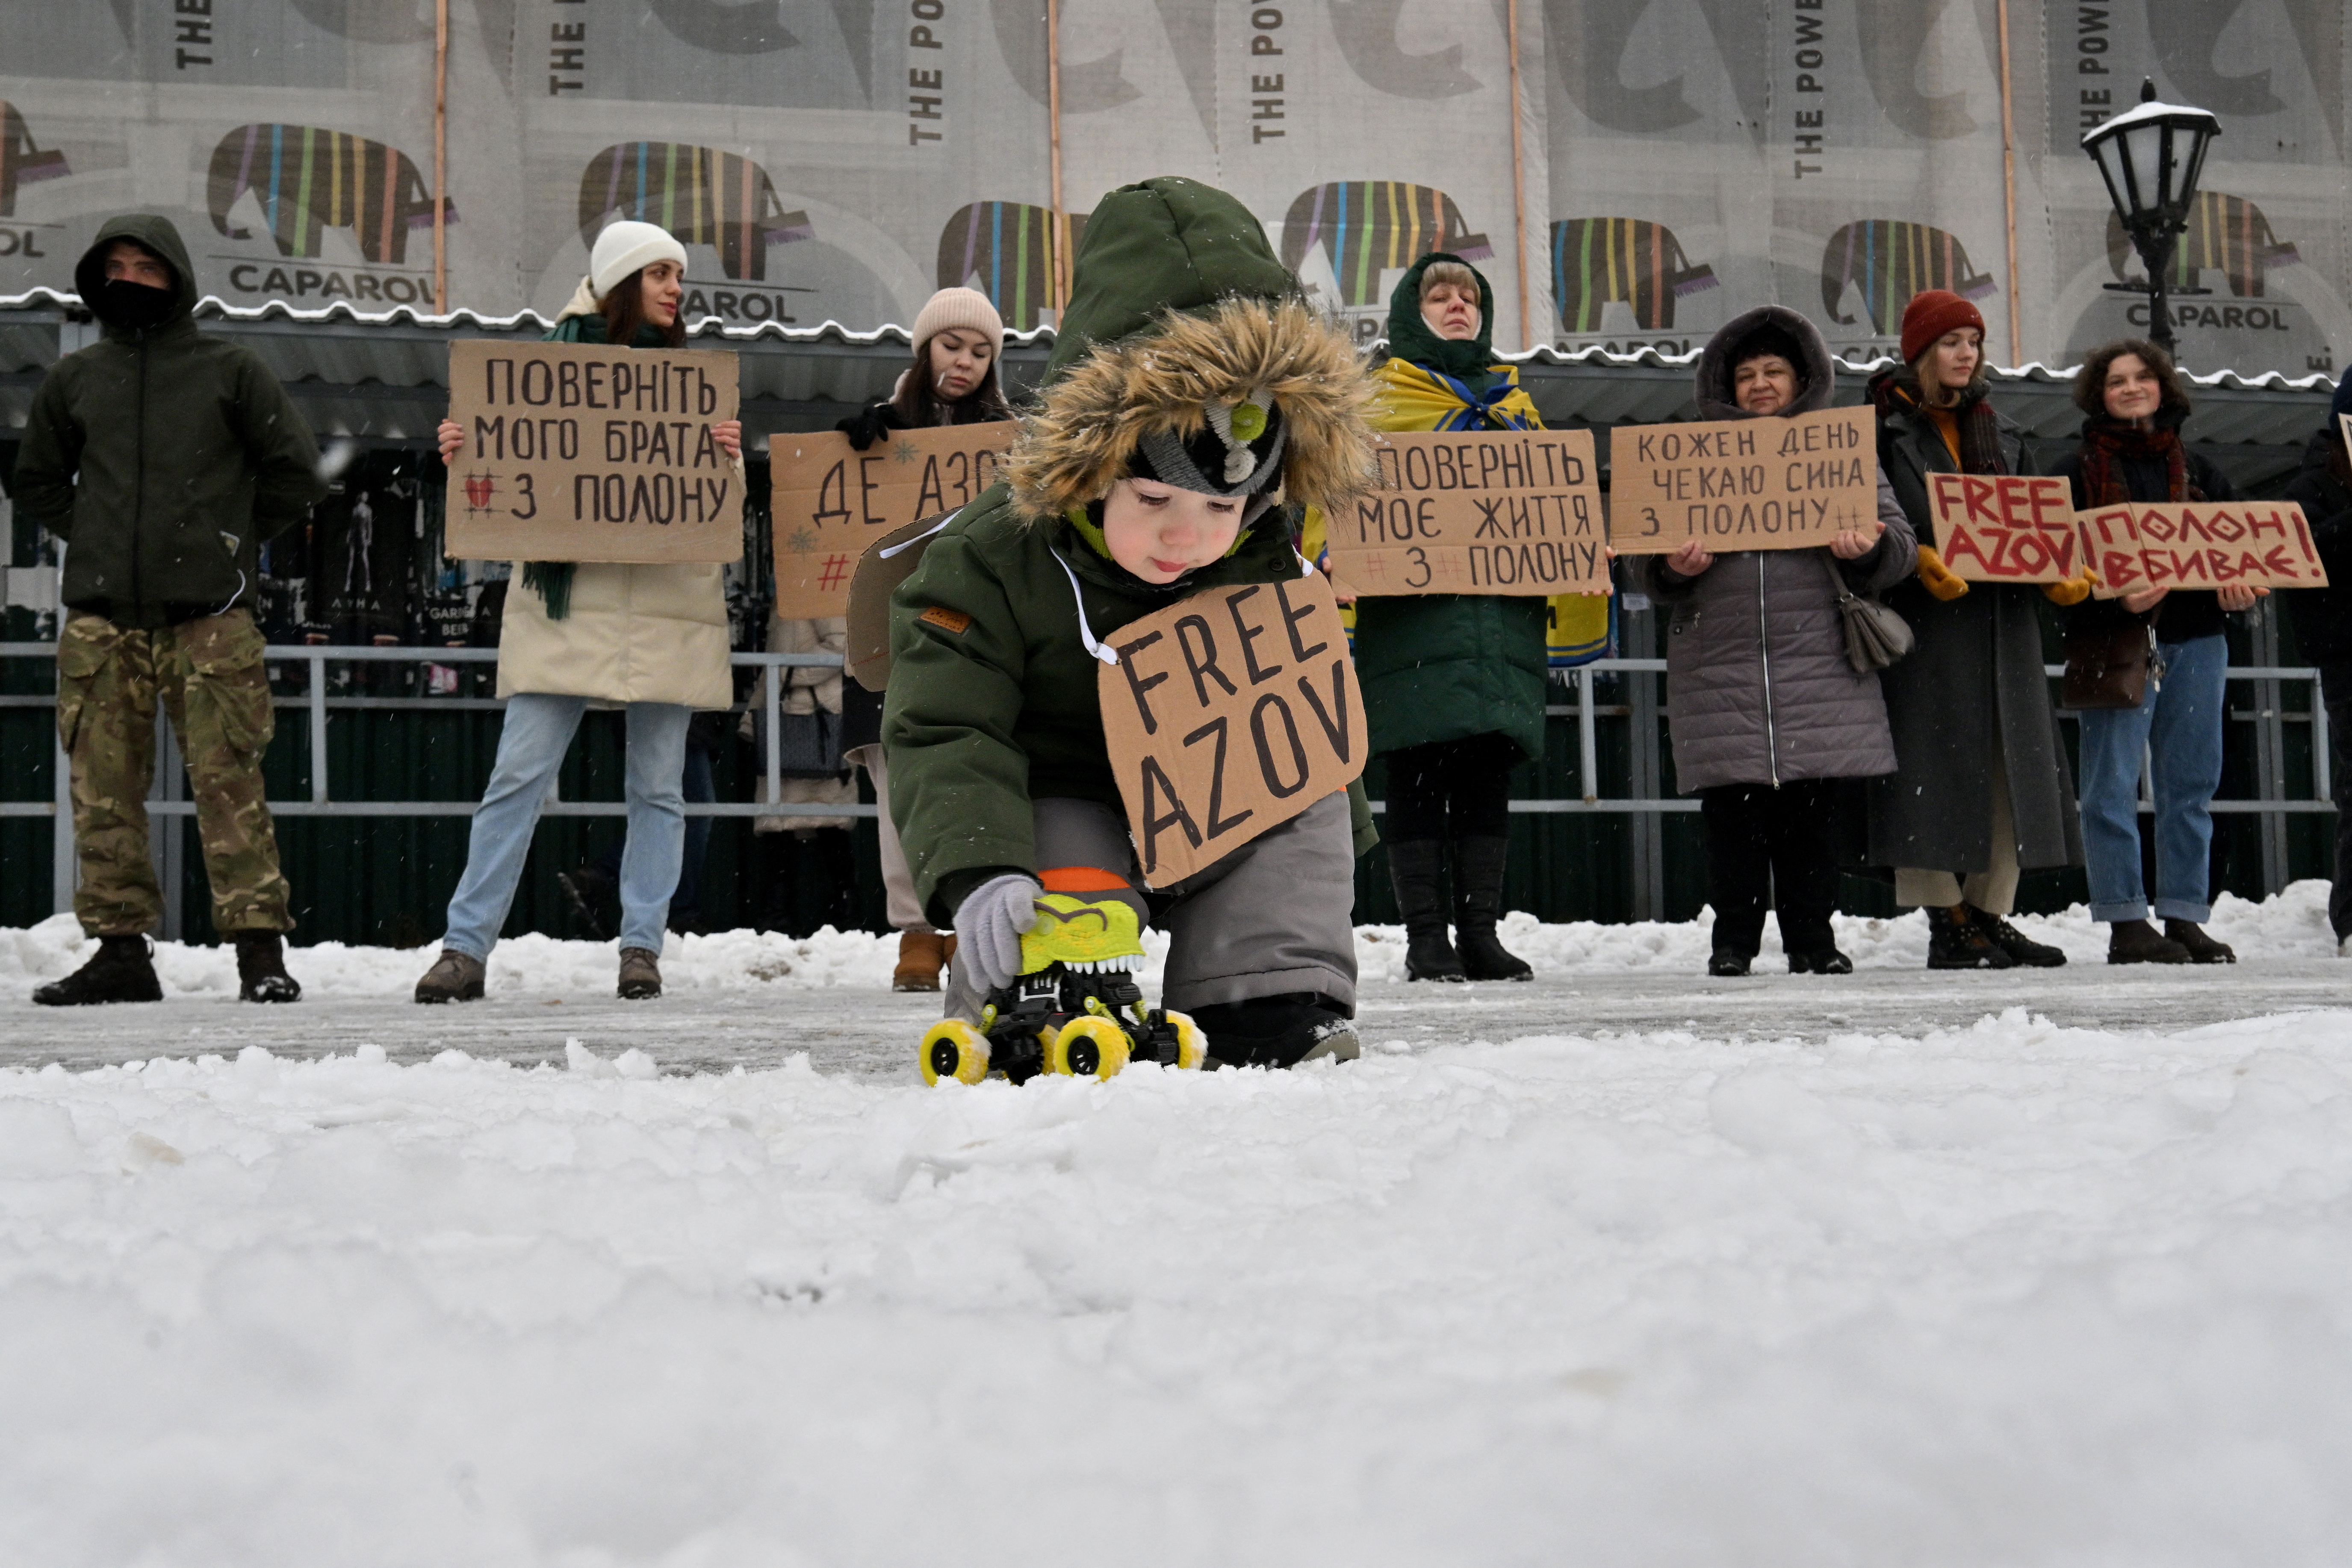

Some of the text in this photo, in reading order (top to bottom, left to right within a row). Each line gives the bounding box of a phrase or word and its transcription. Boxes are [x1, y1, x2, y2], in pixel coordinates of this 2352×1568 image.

[176, 0, 212, 69] THE
[550, 23, 585, 95] THE
[2078, 0, 2110, 74] POW
[1251, 0, 1285, 144] THE PO
[910, 68, 942, 146] THE
[1794, 110, 1823, 180] THE
[230, 264, 436, 301] CAPAROL
[679, 289, 797, 322] AROL
[486, 358, 717, 416] ПОВЕРНІТЬ
[475, 416, 717, 469] МОГО БРАТА
[1376, 439, 1584, 490] ПОВЕРНІТЬ
[1638, 421, 1859, 463] КОЖЕН ДЕНЬ
[574, 472, 727, 525] ПОЛОНУ
[812, 449, 1011, 529] ДЕ АЗО
[1653, 457, 1865, 501] ЧЕКАЮ СИНА
[1934, 476, 2071, 530] FREE
[1357, 495, 1591, 542] МОЄ ЖИТТЯ
[1688, 498, 1829, 535] ПОЛОНУ
[1469, 541, 1597, 586] ПОЛОНУ
[1944, 523, 2075, 578] AZOV
[1116, 582, 1328, 736] FREE
[1141, 659, 1350, 875] AZOV
